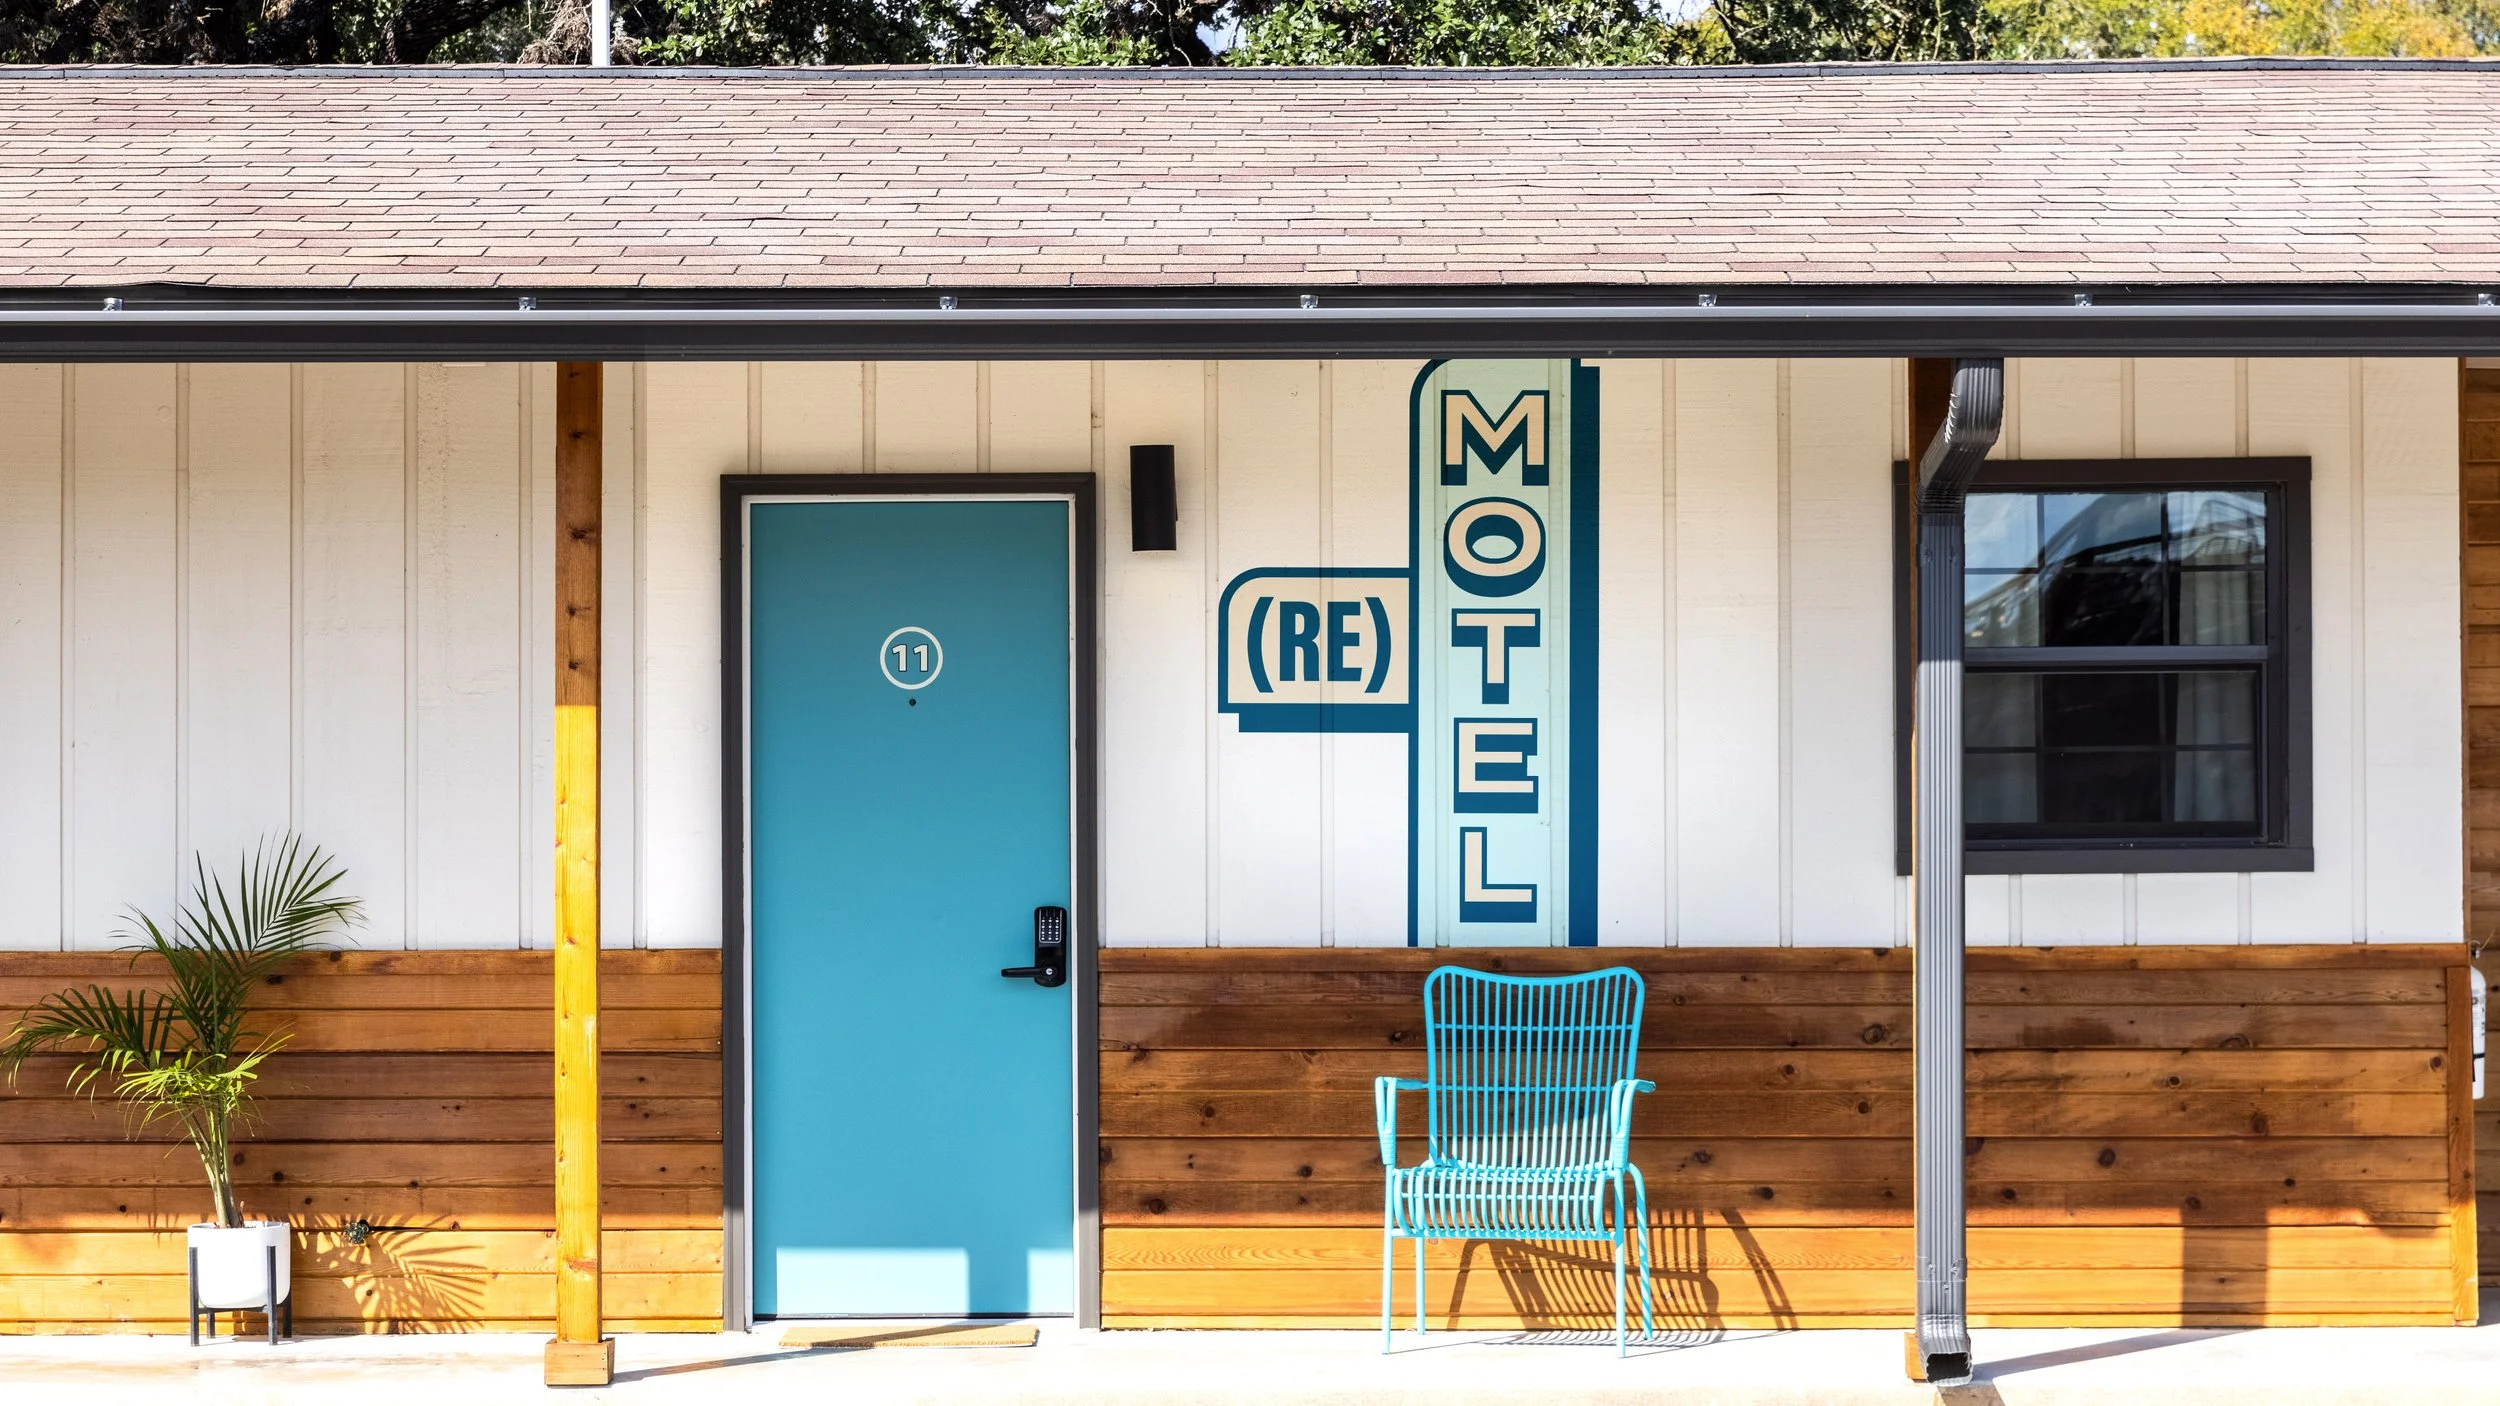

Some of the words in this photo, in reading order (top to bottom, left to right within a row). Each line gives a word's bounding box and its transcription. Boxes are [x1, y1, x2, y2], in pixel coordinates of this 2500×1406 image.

[891, 644, 928, 672] 11
[1247, 597, 1391, 693] (RE)
[1441, 390, 1550, 923] MOTEL
